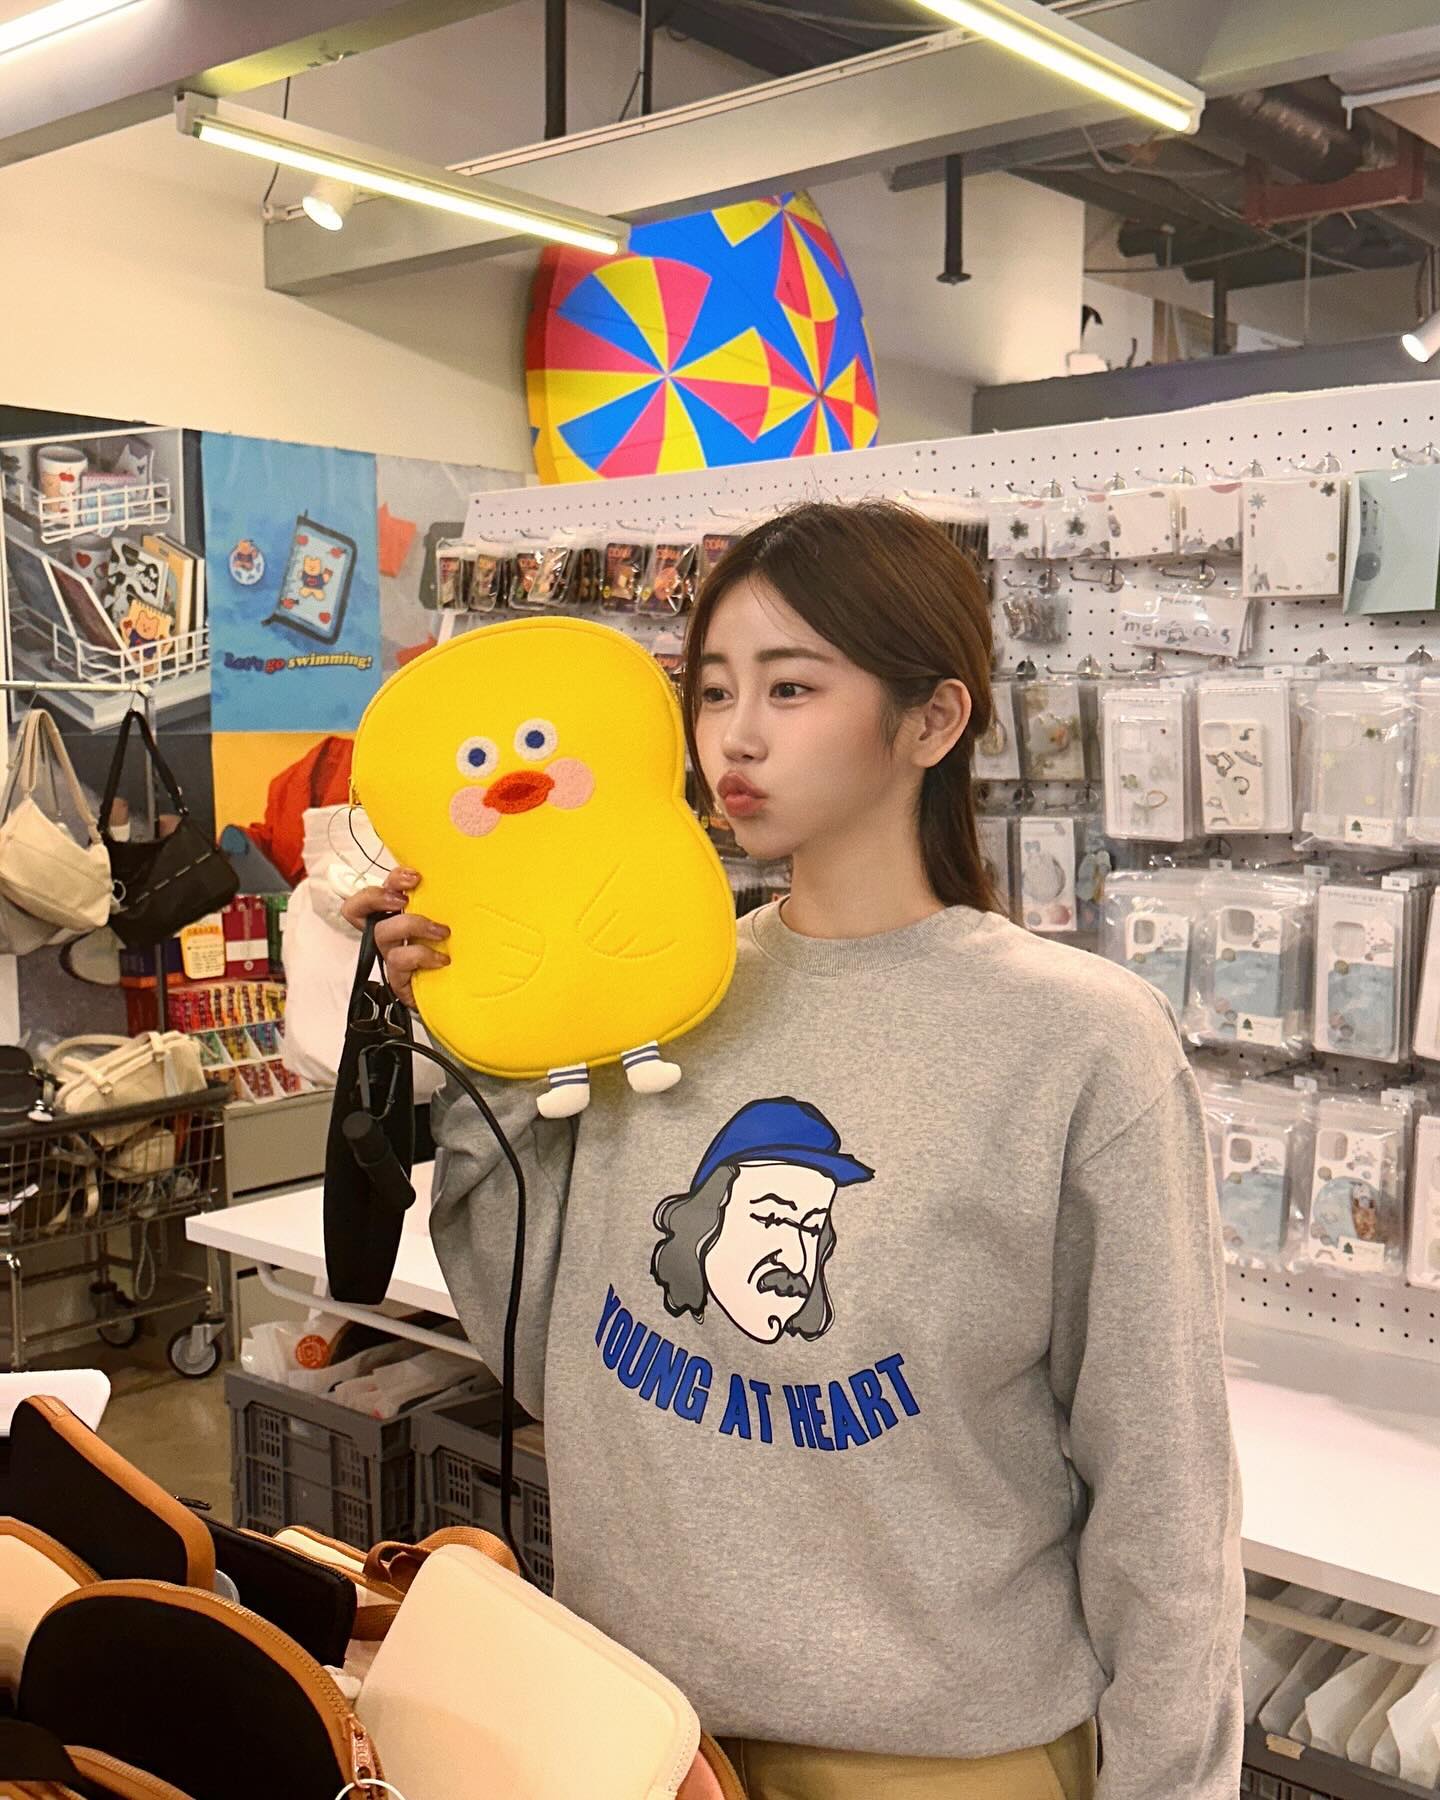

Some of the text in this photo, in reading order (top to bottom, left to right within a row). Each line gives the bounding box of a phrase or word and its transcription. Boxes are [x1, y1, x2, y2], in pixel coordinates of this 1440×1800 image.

[264, 657, 286, 674] go
[287, 651, 373, 670] swimming!
[595, 1283, 921, 1451] YOUNG AT HEART
